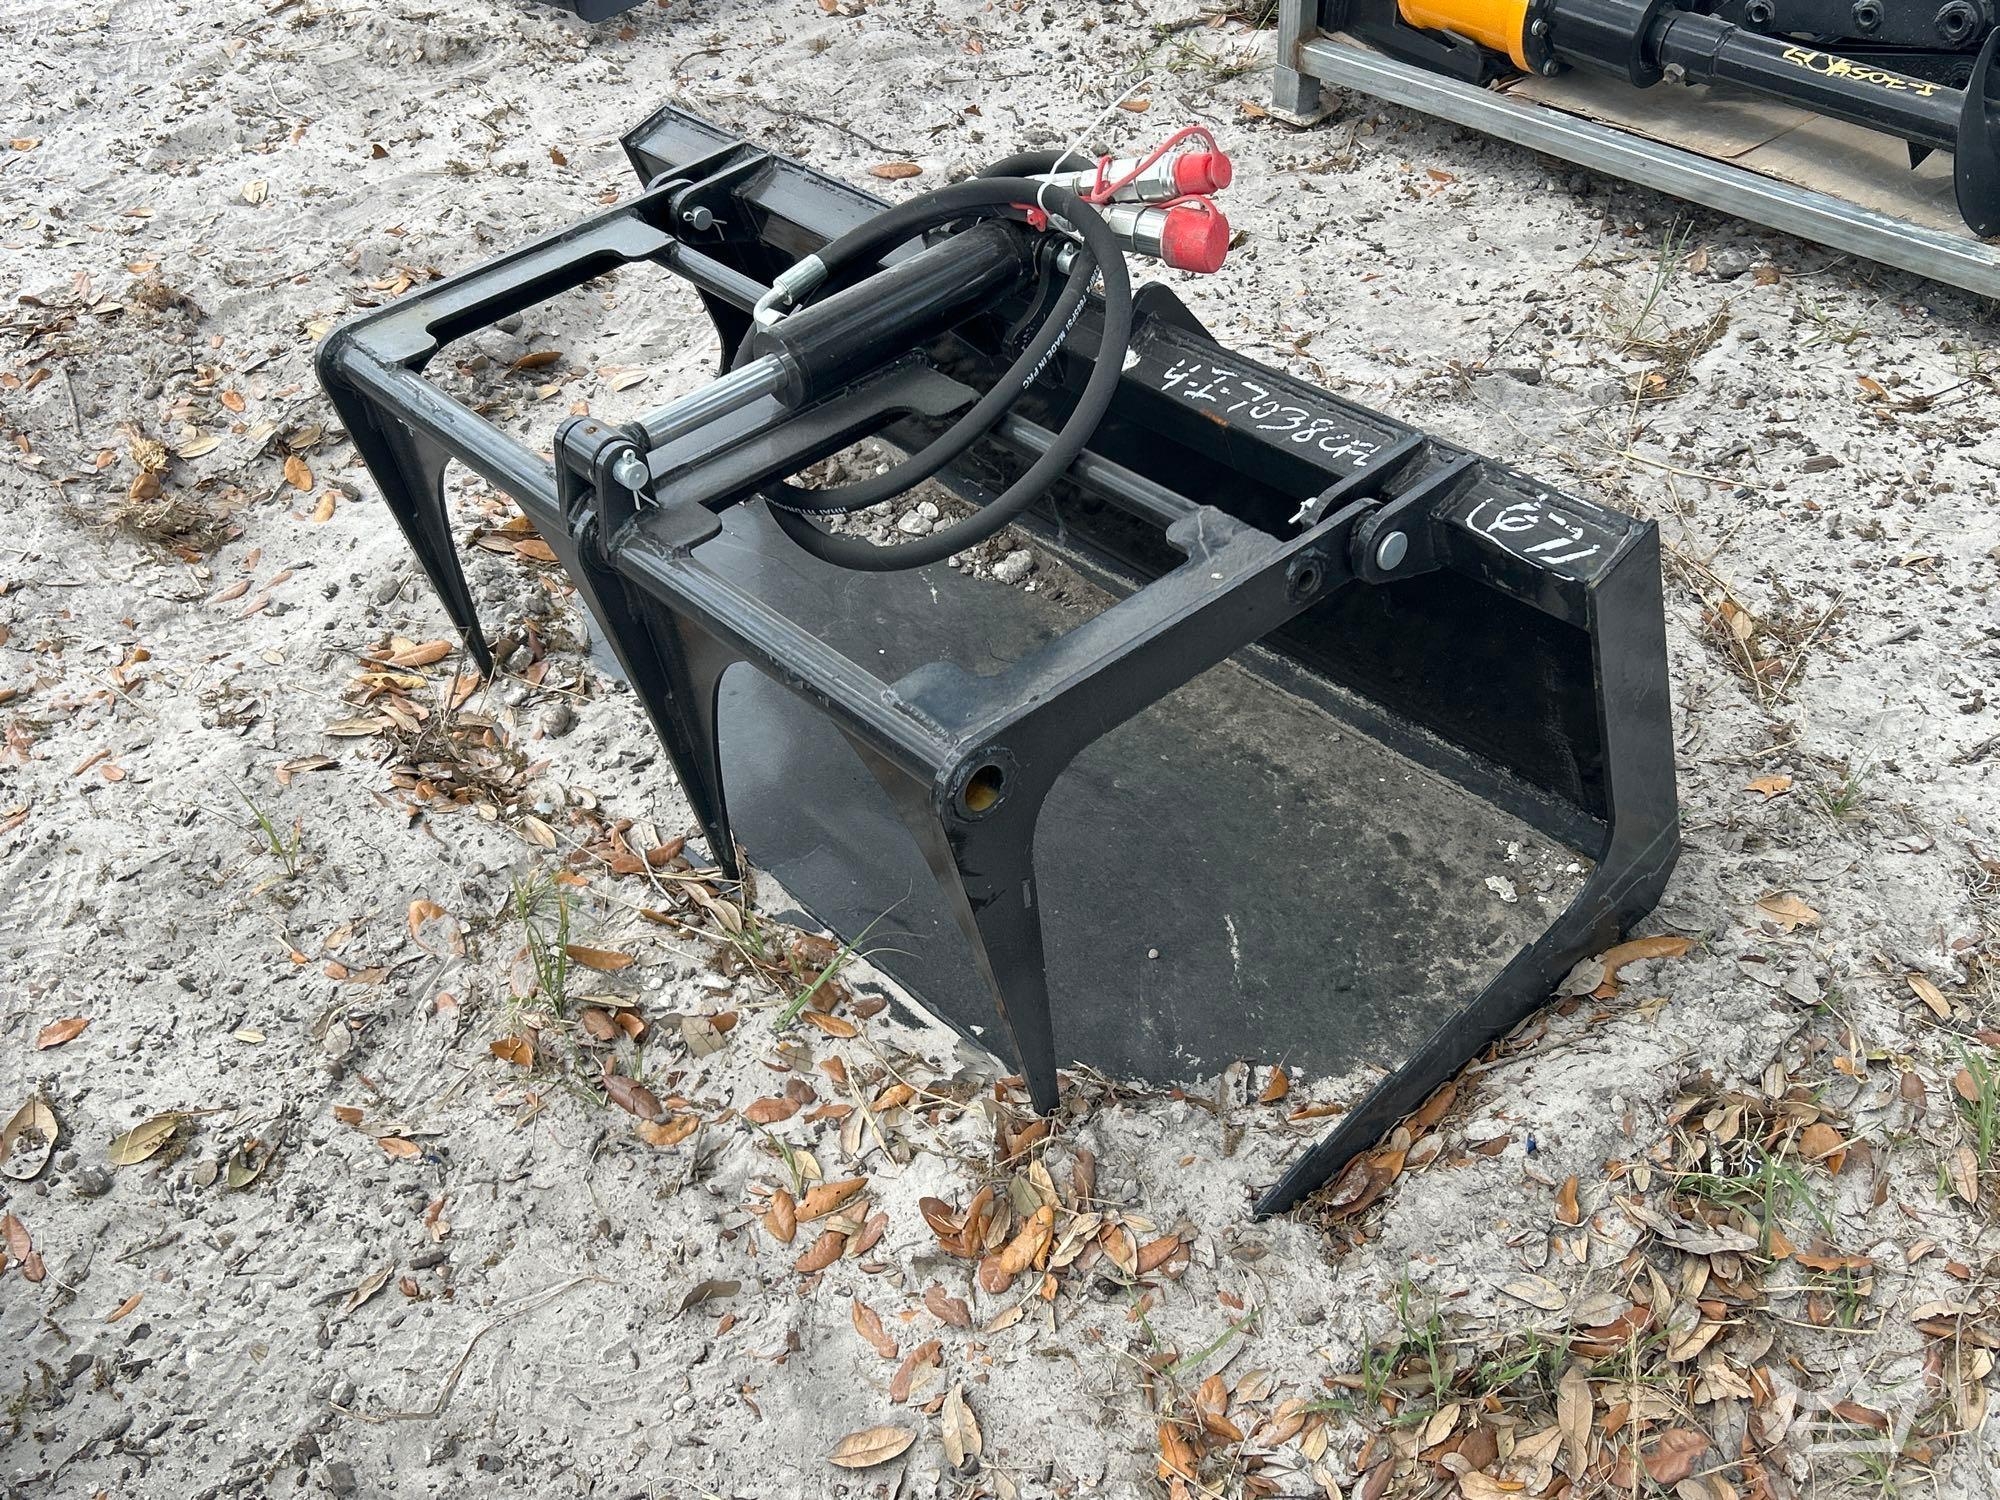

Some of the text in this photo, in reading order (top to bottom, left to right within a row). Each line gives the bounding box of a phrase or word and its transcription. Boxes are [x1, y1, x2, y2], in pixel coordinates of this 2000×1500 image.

[1046, 330, 1067, 360] MADE
[1038, 355, 1048, 372] IN
[1022, 367, 1040, 390] PRC
